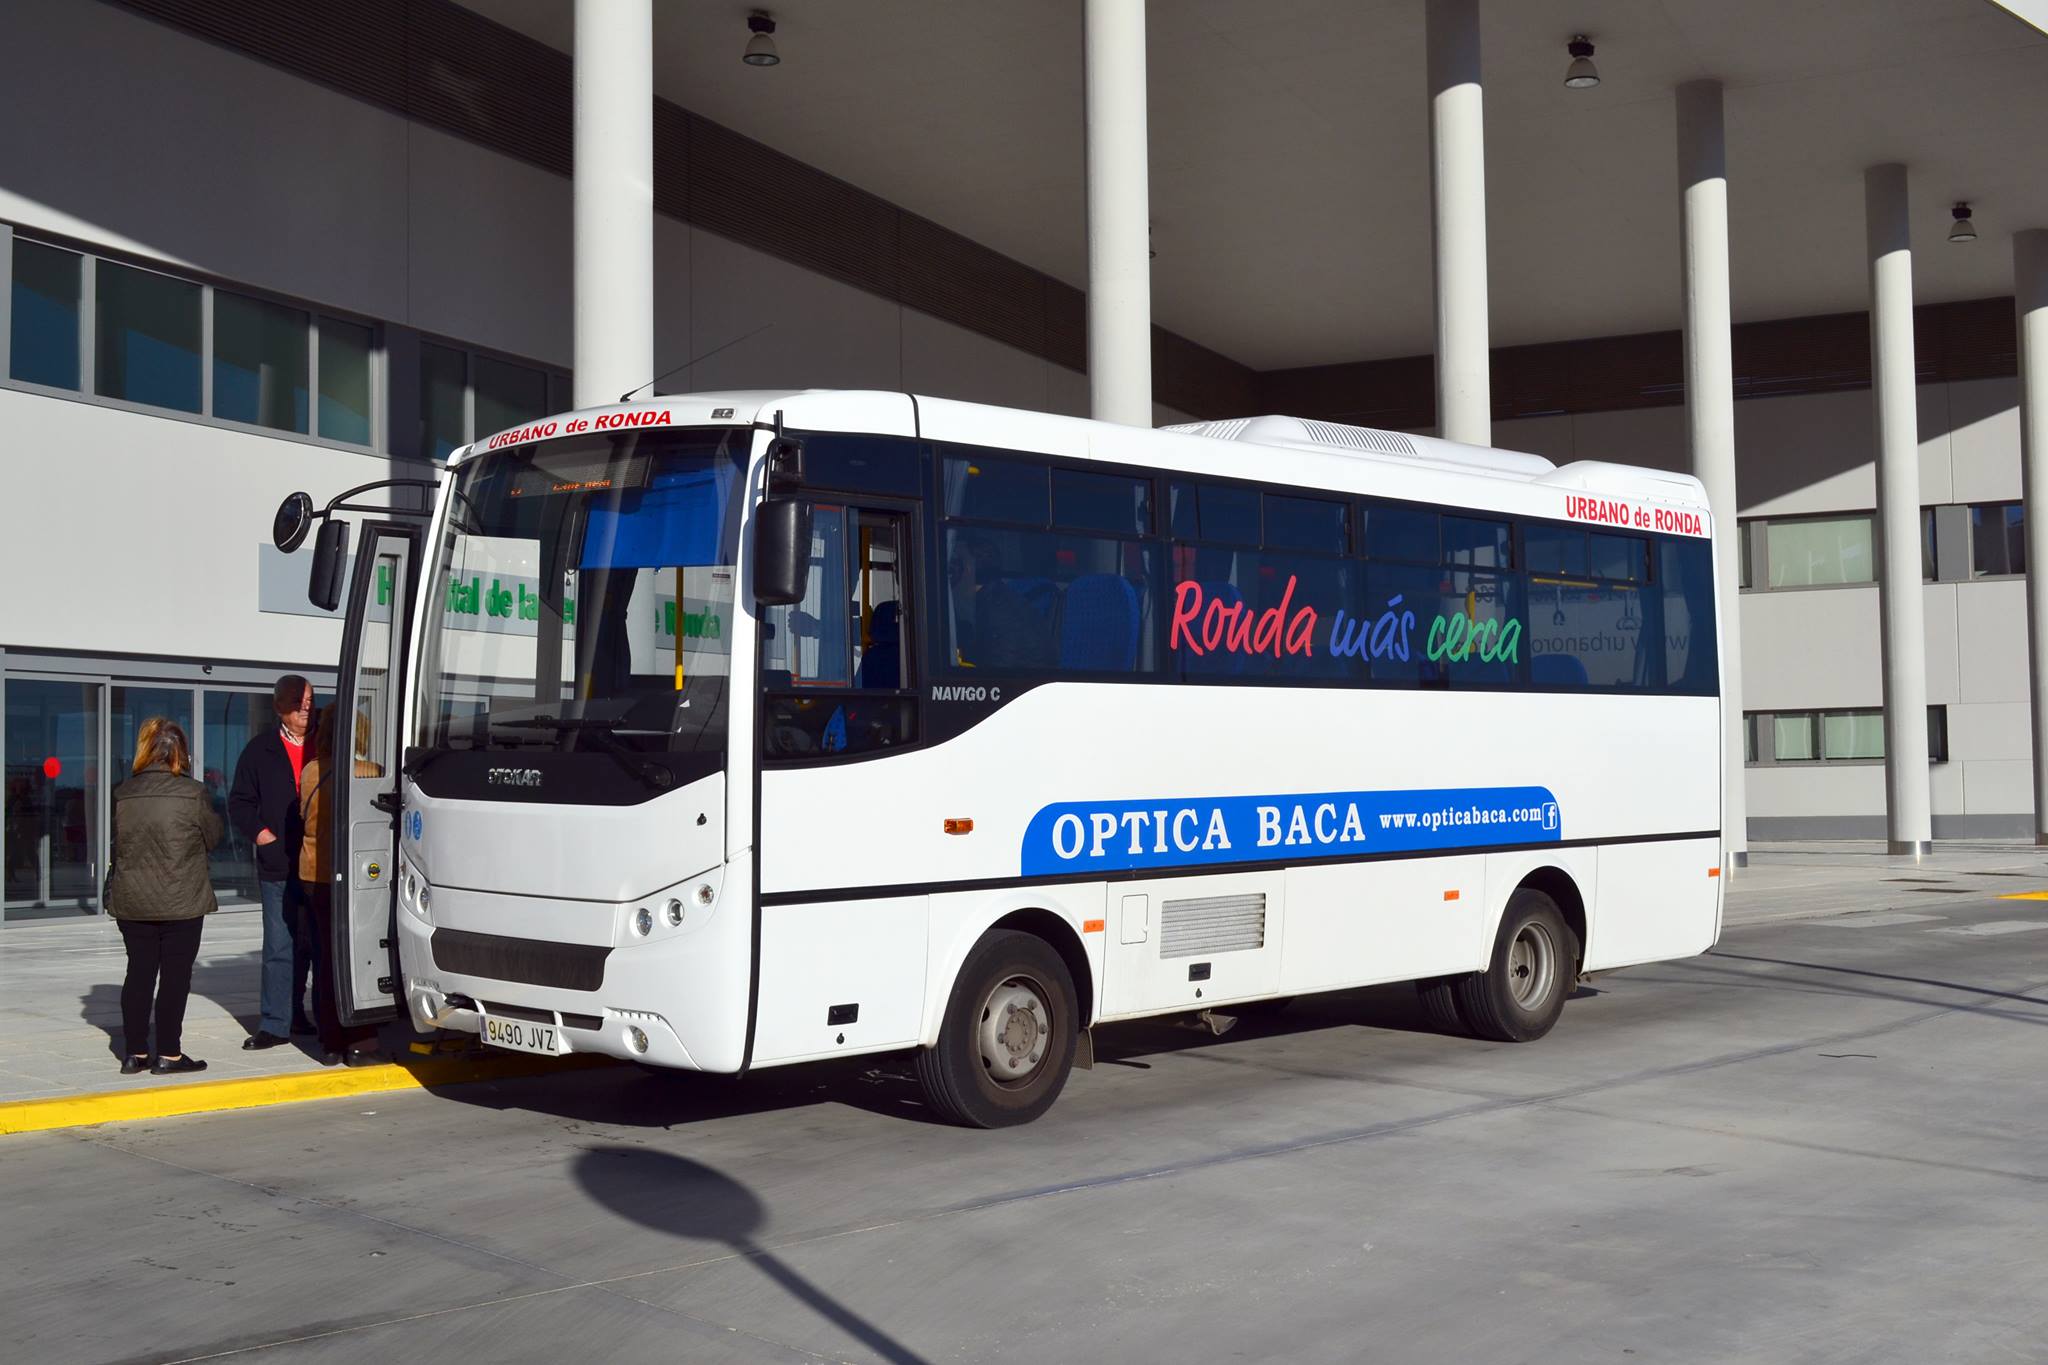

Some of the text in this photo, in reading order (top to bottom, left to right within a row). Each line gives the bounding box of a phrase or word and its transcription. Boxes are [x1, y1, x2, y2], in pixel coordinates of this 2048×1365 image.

[488, 410, 671, 449] URBANO de RONDA
[1566, 495, 1702, 535] URBANO de RONDA
[484, 579, 513, 618] de
[1170, 575, 1522, 665] Ronda más cerca
[931, 686, 1001, 701] NAVIGO C
[488, 767, 541, 786] OTOKAR
[1052, 808, 1232, 860] OPTICA
[1257, 803, 1366, 847] BACA
[1379, 806, 1542, 832] www.opticabaca.com
[488, 1021, 554, 1051] 9490 JVZ
